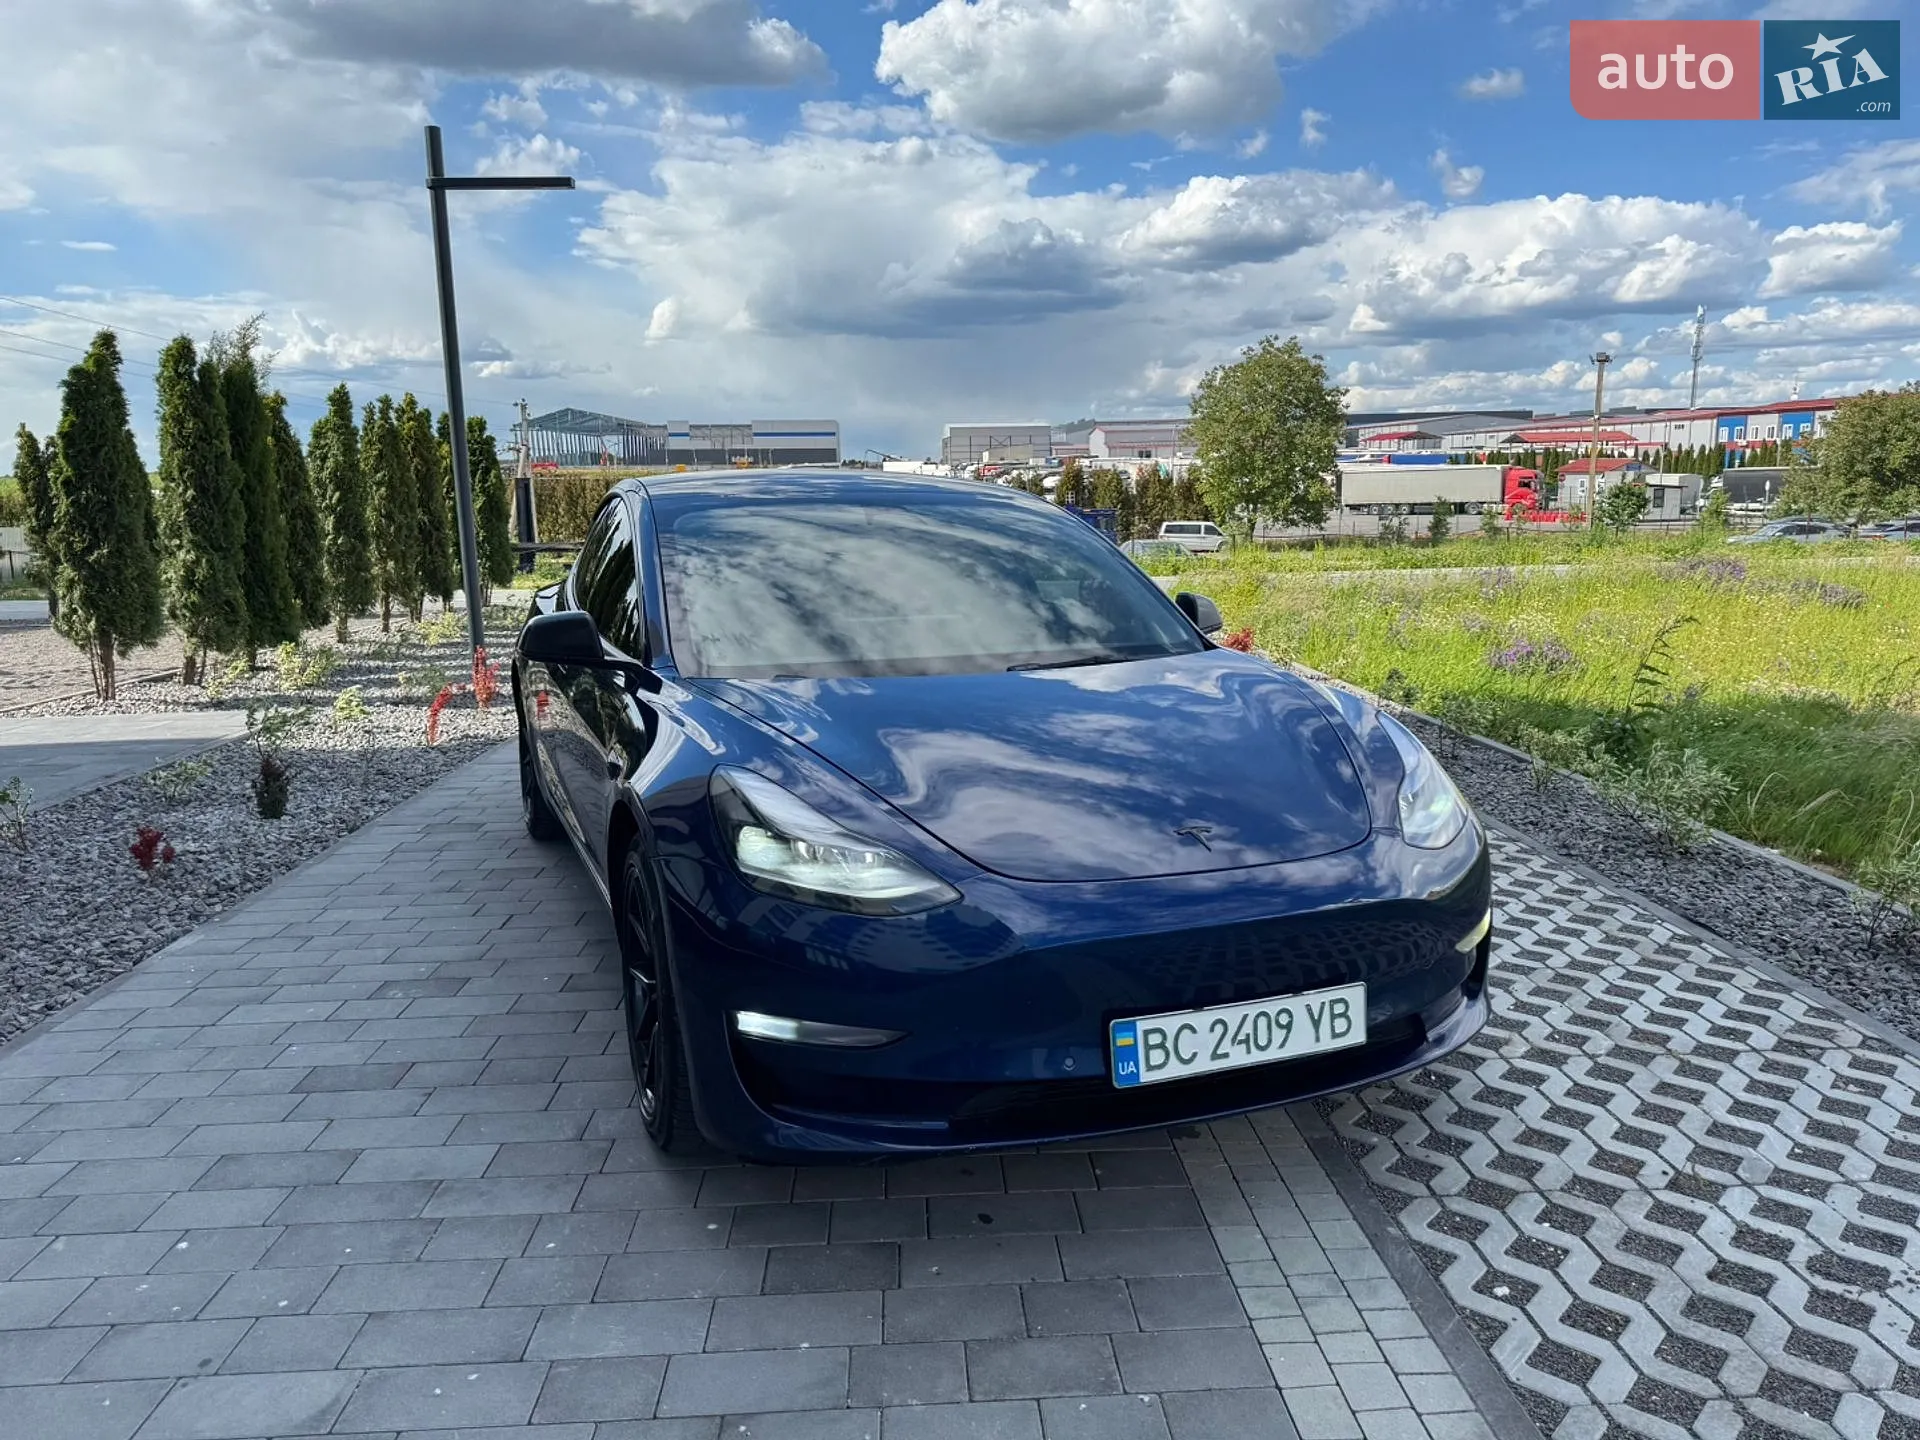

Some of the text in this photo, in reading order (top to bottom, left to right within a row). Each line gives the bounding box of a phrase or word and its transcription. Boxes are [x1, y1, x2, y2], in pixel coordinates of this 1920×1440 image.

[1142, 997, 1352, 1072] BC 2409 YB
[1118, 1061, 1137, 1075] UA
